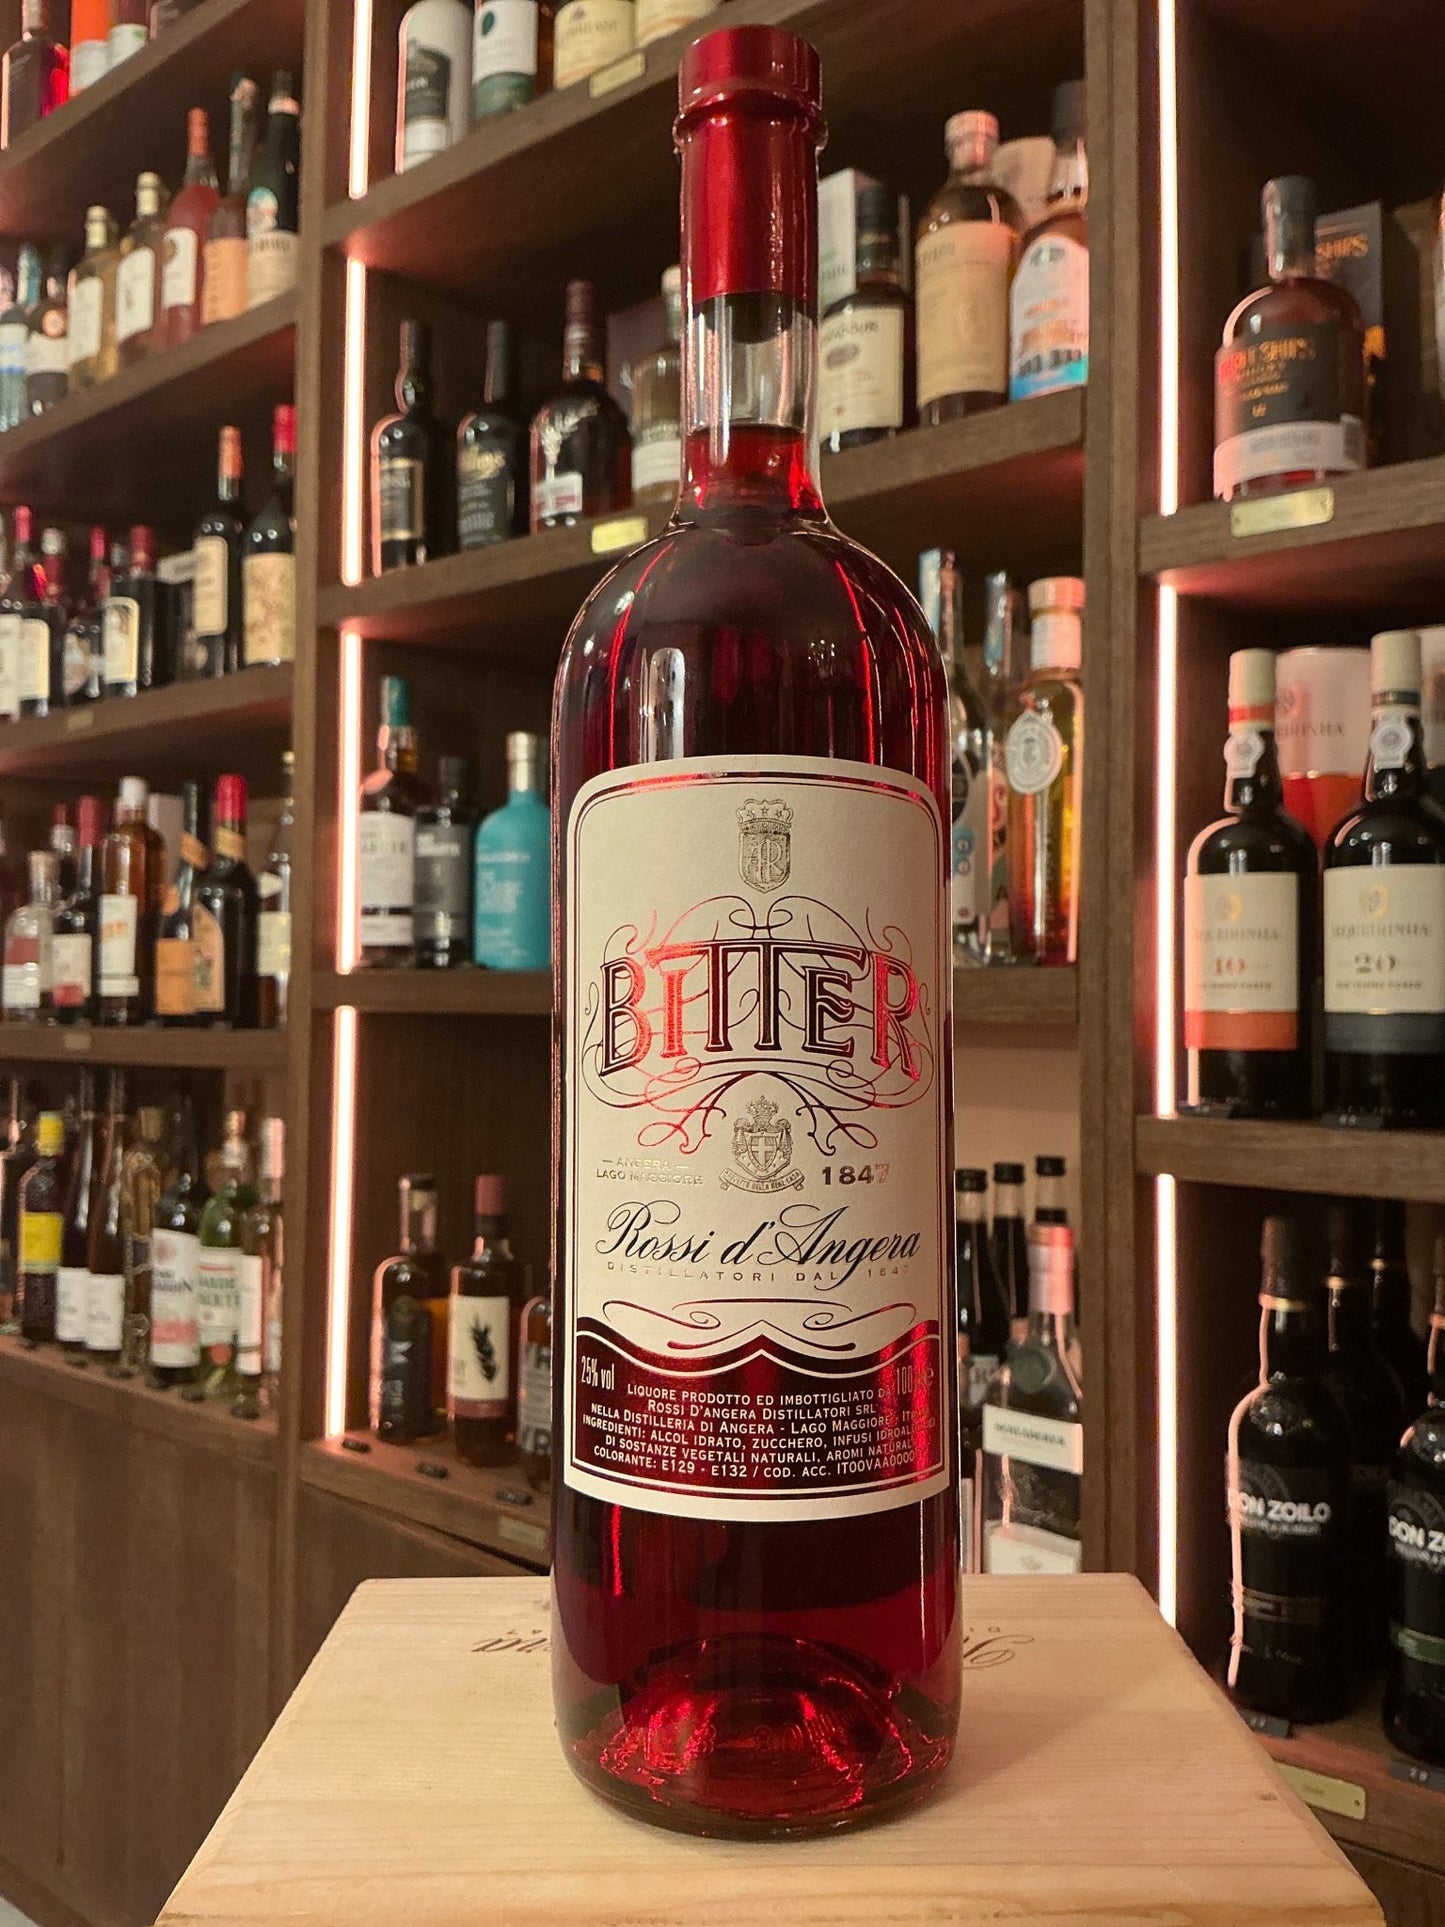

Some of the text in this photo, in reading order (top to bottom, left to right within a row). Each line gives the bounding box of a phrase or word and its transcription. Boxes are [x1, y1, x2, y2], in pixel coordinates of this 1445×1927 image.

[599, 938, 921, 1082] BITTER
[596, 1168, 704, 1186] LAGO MAGGIORE
[616, 1157, 671, 1172] ANGERA
[822, 1163, 890, 1186] 1847
[595, 1199, 921, 1291] Rossi d'Angera
[607, 1261, 774, 1282] DISTILLATORI
[796, 1271, 838, 1282] DAL
[581, 1355, 598, 1387] 25%
[601, 1363, 615, 1391] vol
[627, 1383, 677, 1401] LIQUORE
[682, 1391, 751, 1406] PRODOTTO
[756, 1395, 774, 1406] ED
[780, 1389, 874, 1406] IMBOTTIGLIATO
[591, 1402, 620, 1419] NELLA
[623, 1409, 695, 1431] DISTILLERIA
[700, 1421, 713, 1432] DI
[719, 1421, 774, 1434] ANGERA
[791, 1422, 827, 1434] LAGO
[832, 1415, 891, 1433] MAGGIORE
[647, 1399, 685, 1416] ROSSI
[763, 1406, 850, 1420] DISTILLATORI
[855, 1403, 876, 1415] SRL
[582, 1413, 646, 1439] INGREDIENTI:
[650, 1429, 689, 1445] ALCOL
[694, 1435, 746, 1450] IDRATO,
[752, 1437, 827, 1449] ZUCCHERO,
[833, 1432, 872, 1447] INFUSI
[594, 1445, 657, 1469] COLORANTE:
[662, 1459, 695, 1474] E129
[711, 1464, 747, 1477] E132
[763, 1467, 796, 1478] COD.
[802, 1465, 831, 1477] ACC.
[605, 1434, 616, 1446] DI
[619, 1437, 677, 1458] SOSTANZE
[682, 1447, 745, 1463] VEGETALI
[826, 1447, 863, 1462] AROMI
[868, 1439, 916, 1456] NATURAL
[1267, 1500, 1331, 1524] ZOILO
[1388, 1515, 1445, 1553] DON Z
